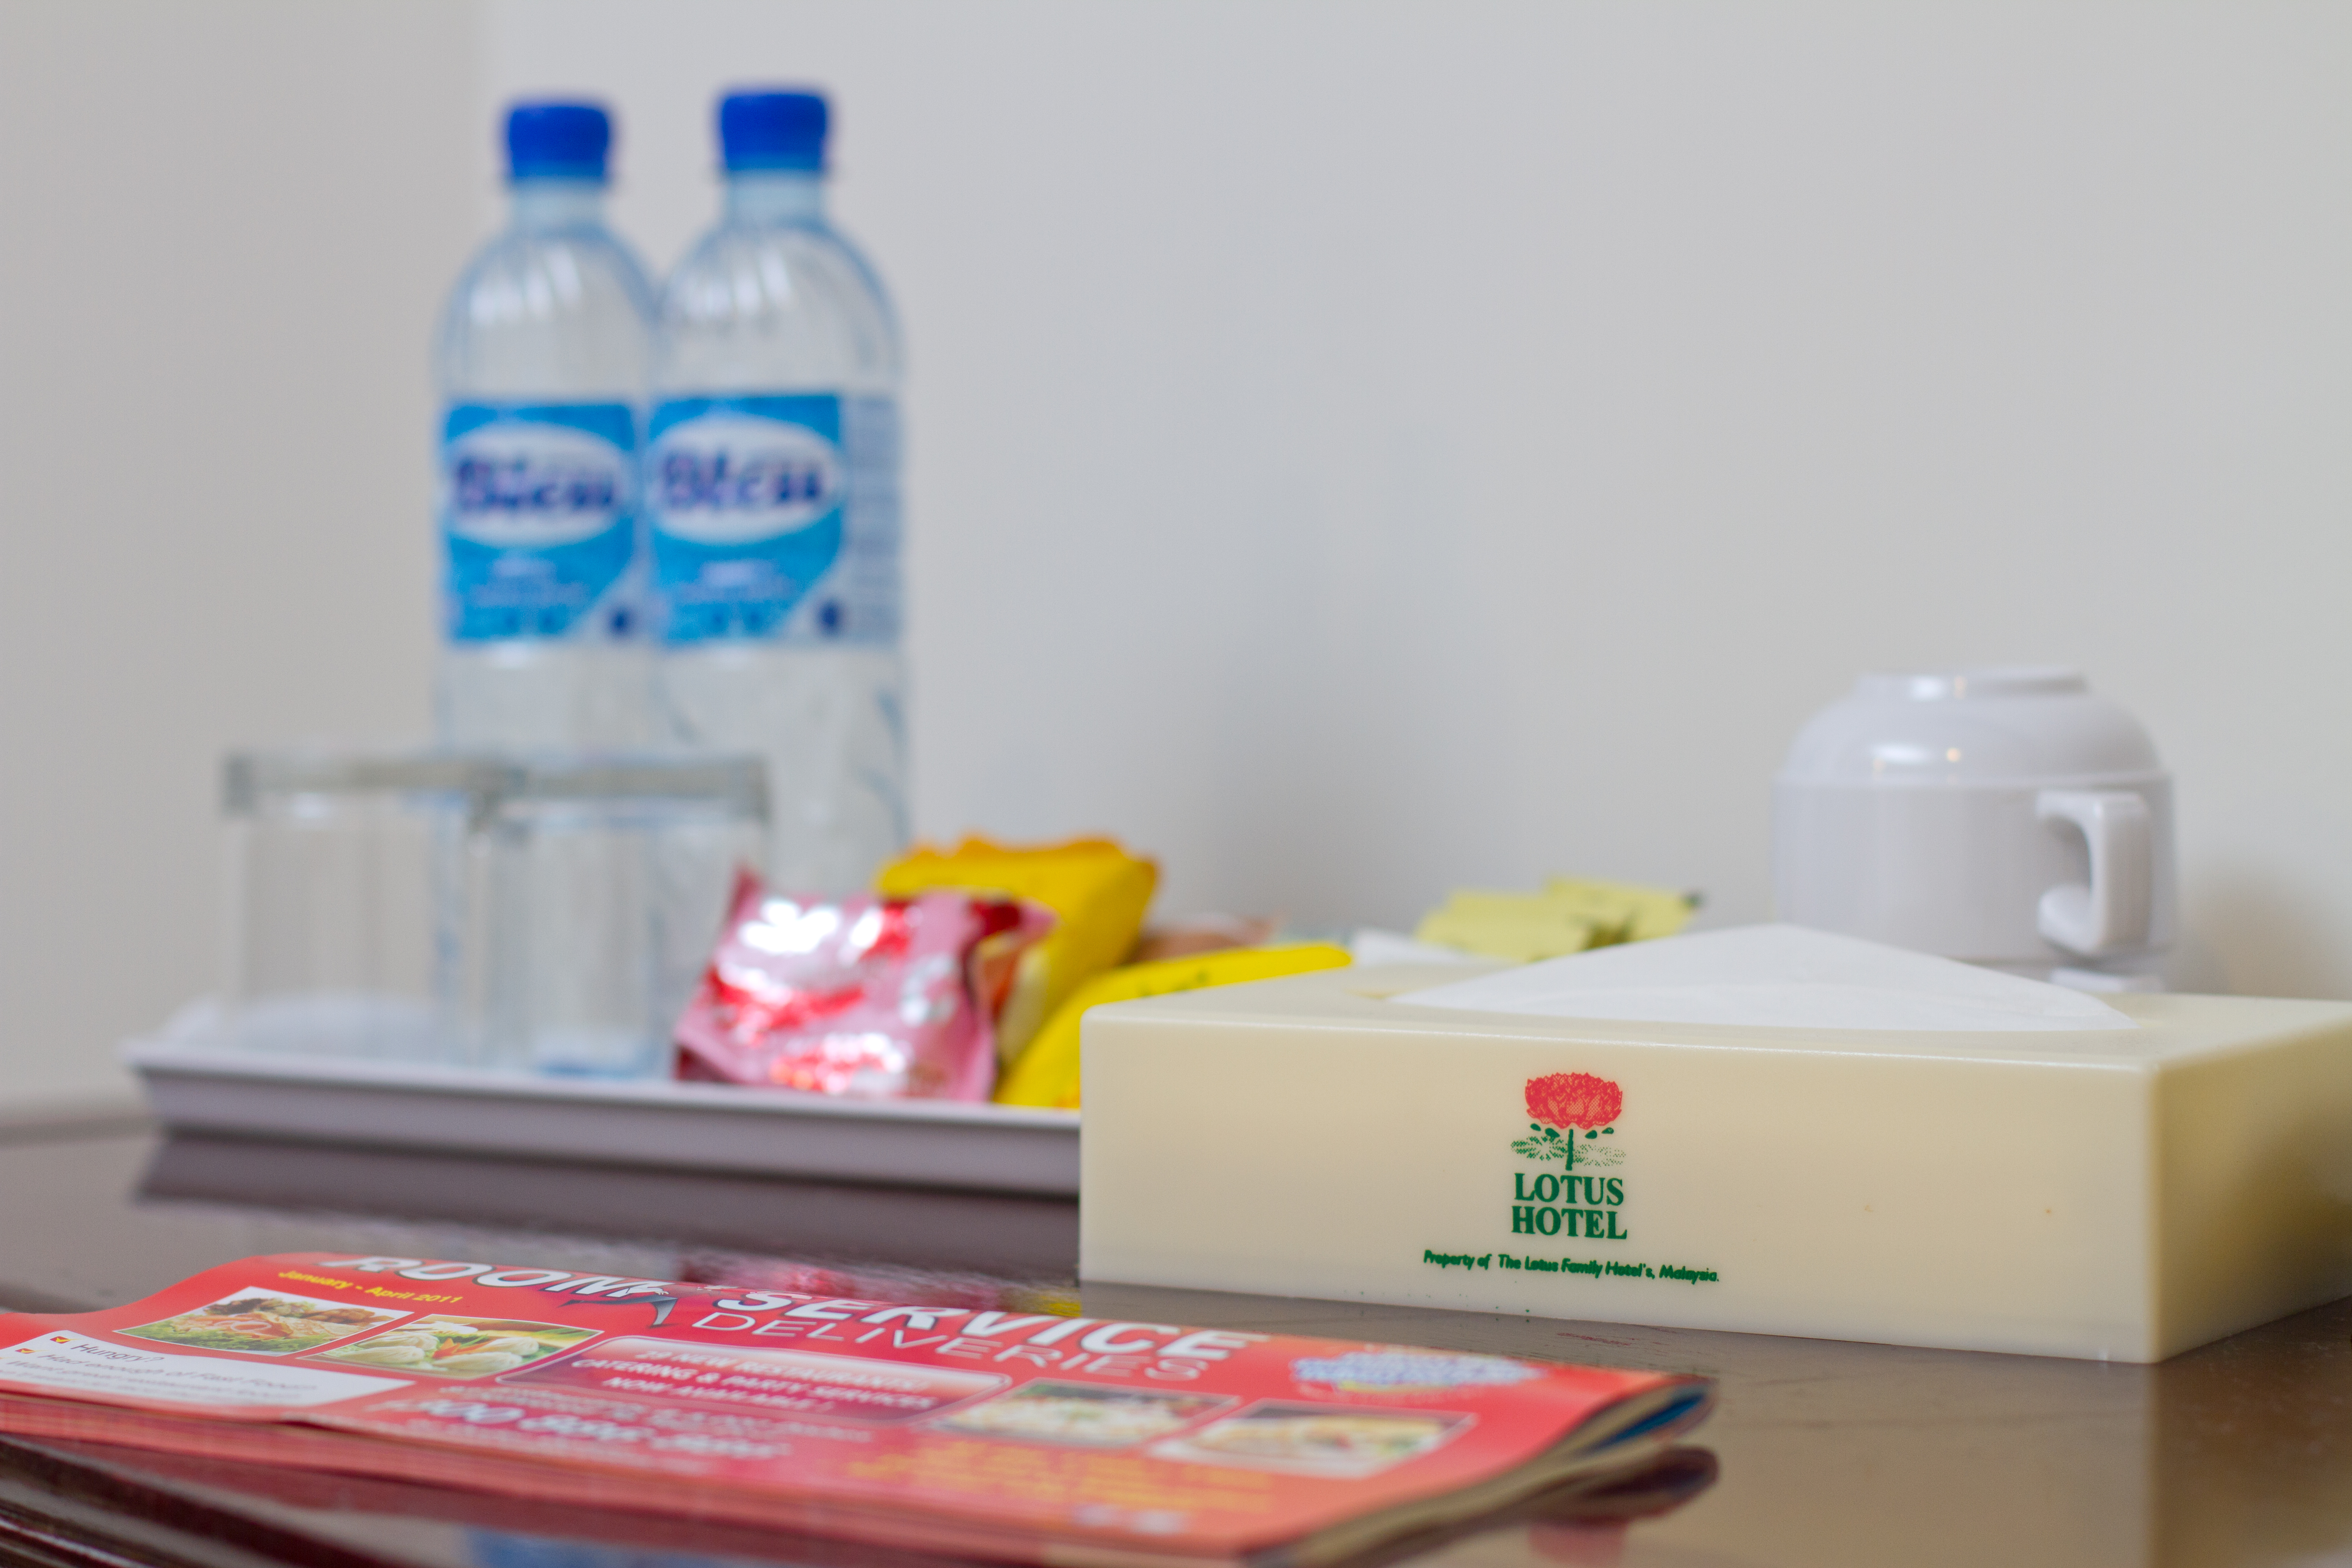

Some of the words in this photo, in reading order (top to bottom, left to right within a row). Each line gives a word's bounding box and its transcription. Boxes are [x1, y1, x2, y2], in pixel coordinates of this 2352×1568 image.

[1514, 1173, 1624, 1206] LOTUS
[1511, 1205, 1627, 1240] HOTEL
[1424, 1250, 1475, 1270] Property
[1477, 1254, 1492, 1270] of
[1498, 1254, 1521, 1269] The
[1524, 1256, 1558, 1272] Lotus
[1561, 1258, 1603, 1279] Family
[1659, 1265, 1720, 1285] Malaysia.
[278, 1270, 354, 1289] January
[365, 1287, 416, 1299] April
[412, 1294, 463, 1303] 2011
[717, 1291, 1270, 1359] SERVICE
[37, 1354, 90, 1364] Had
[70, 1344, 165, 1362] Hungry?
[671, 1353, 738, 1367] NEW
[691, 1312, 1209, 1381] DELIVERIES
[571, 1359, 700, 1380] CATERING
[695, 1372, 721, 1383] &
